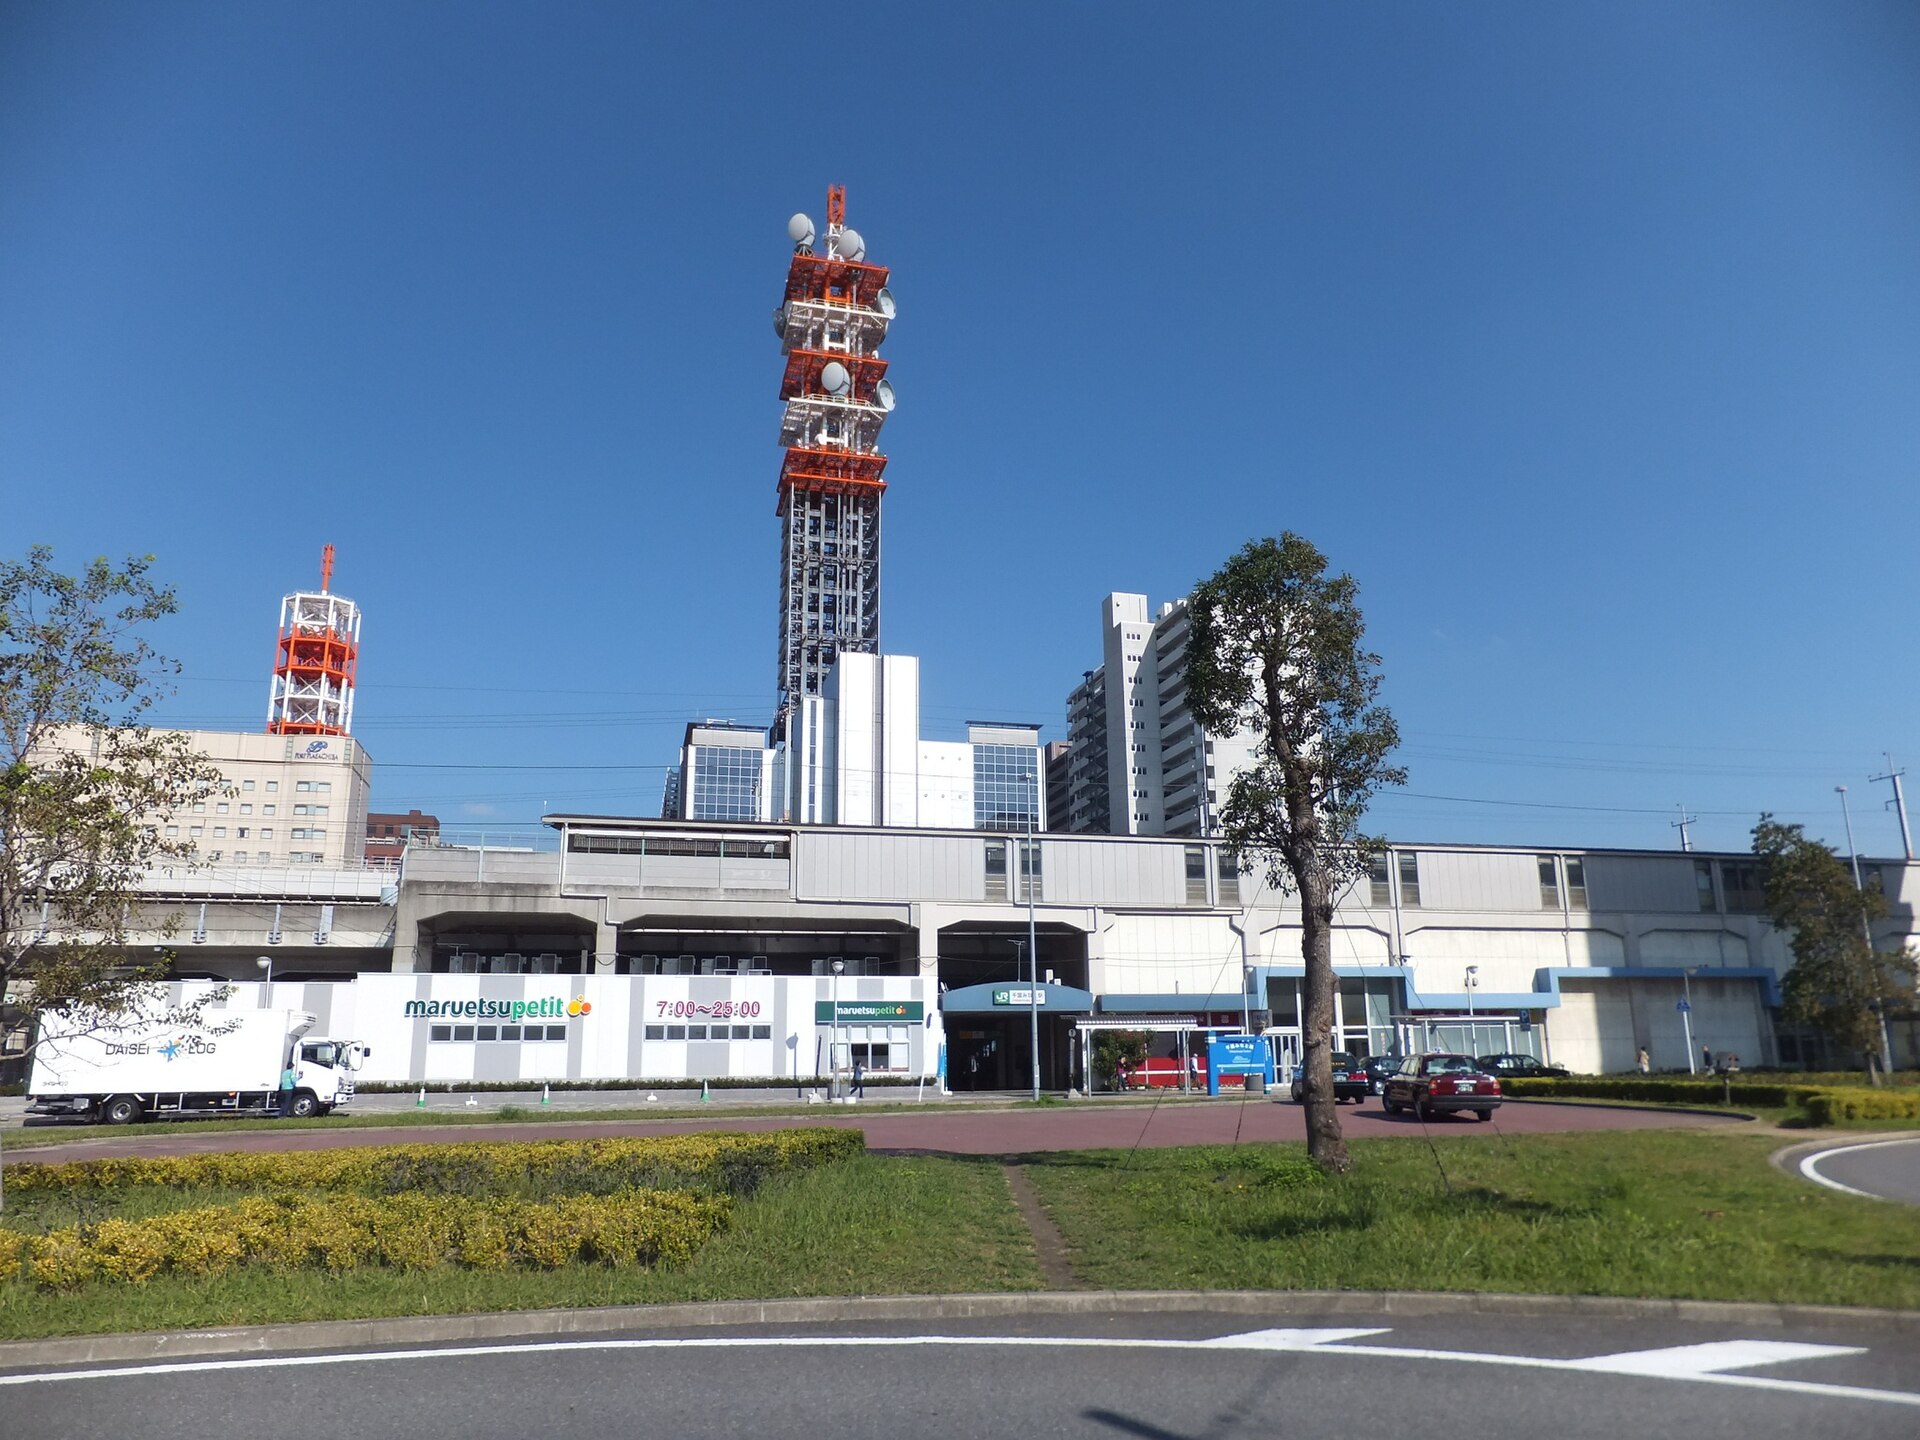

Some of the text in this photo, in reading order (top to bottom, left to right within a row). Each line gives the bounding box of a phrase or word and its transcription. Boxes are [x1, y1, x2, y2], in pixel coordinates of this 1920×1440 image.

[996, 992, 1009, 1000] JR
[1521, 1010, 1529, 1022] P
[188, 1043, 216, 1055] LOG
